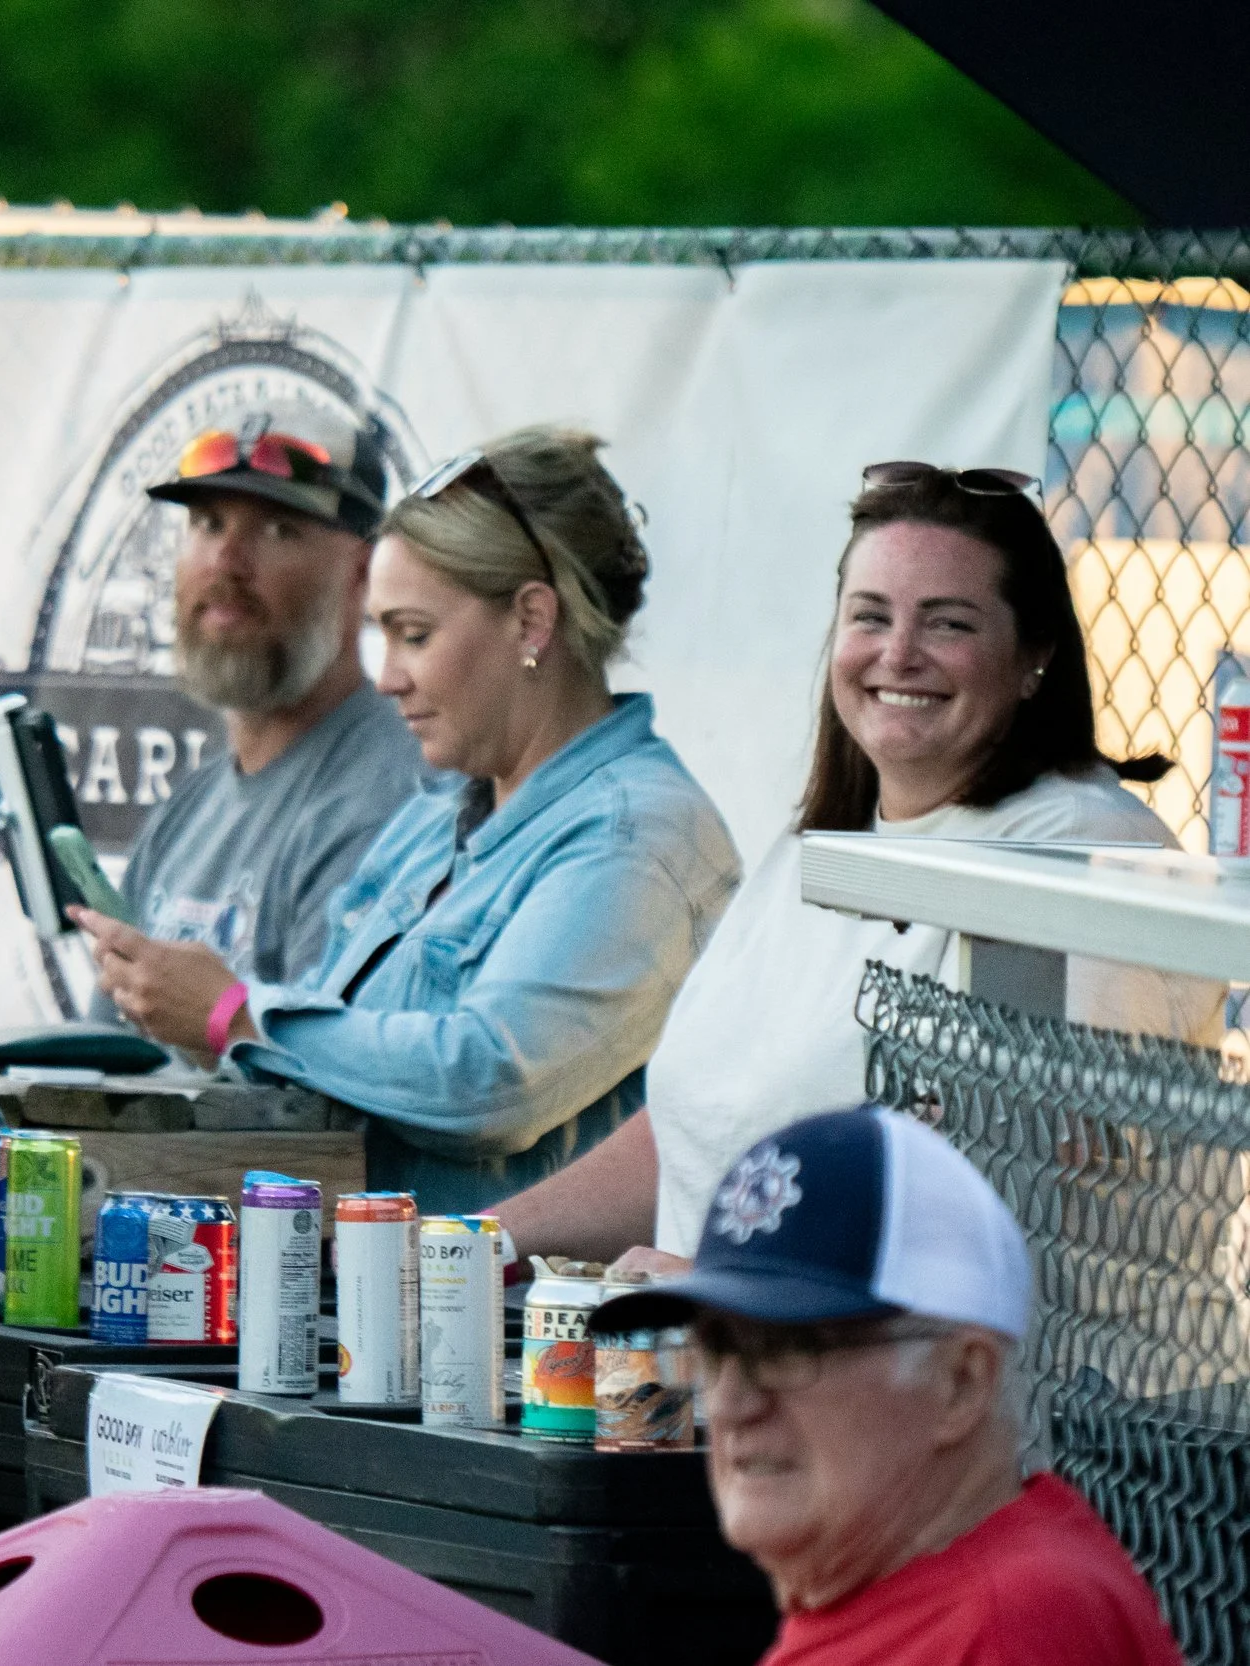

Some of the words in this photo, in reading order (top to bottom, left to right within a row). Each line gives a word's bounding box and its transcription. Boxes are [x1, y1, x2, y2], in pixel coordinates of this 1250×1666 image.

[95, 1260, 149, 1290] BUD
[91, 1287, 148, 1315] IGH
[148, 1285, 193, 1303] eiser
[543, 1311, 586, 1326] BEA
[543, 1326, 592, 1340] PLEA
[97, 1414, 123, 1443] GOOD
